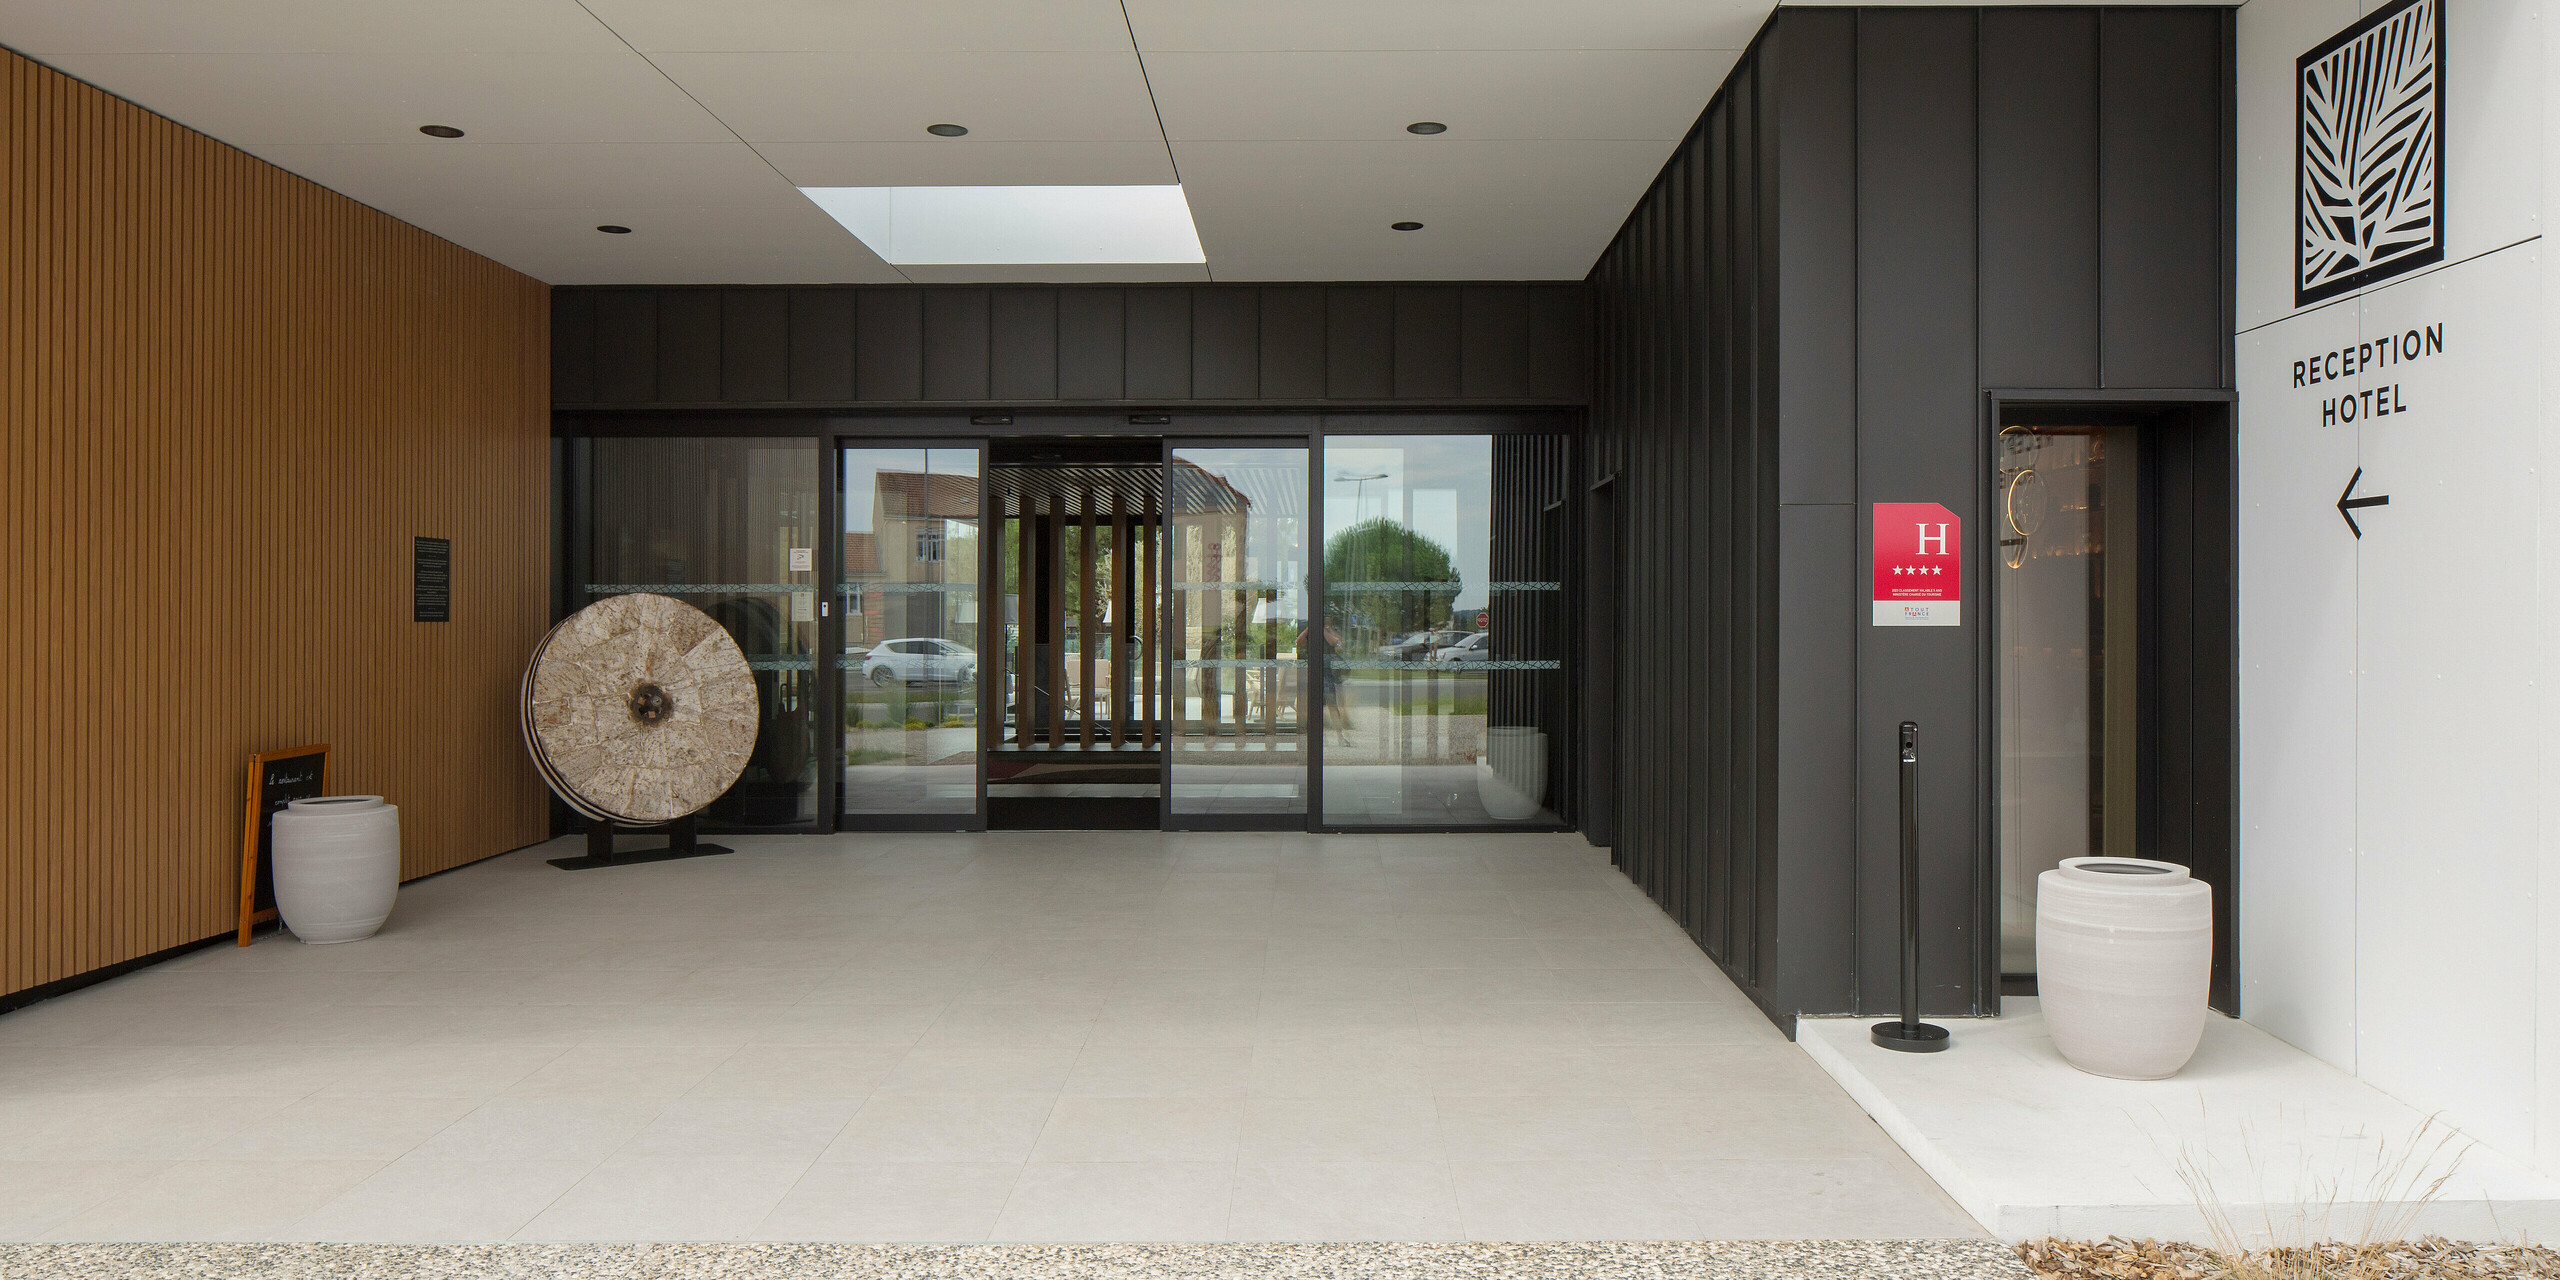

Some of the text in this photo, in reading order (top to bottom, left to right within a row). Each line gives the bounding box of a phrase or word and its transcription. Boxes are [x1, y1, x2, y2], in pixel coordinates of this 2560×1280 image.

[2293, 322, 2443, 388] RECEPTION
[2322, 383, 2407, 427] HOTEL
[1915, 523, 1950, 555] H
